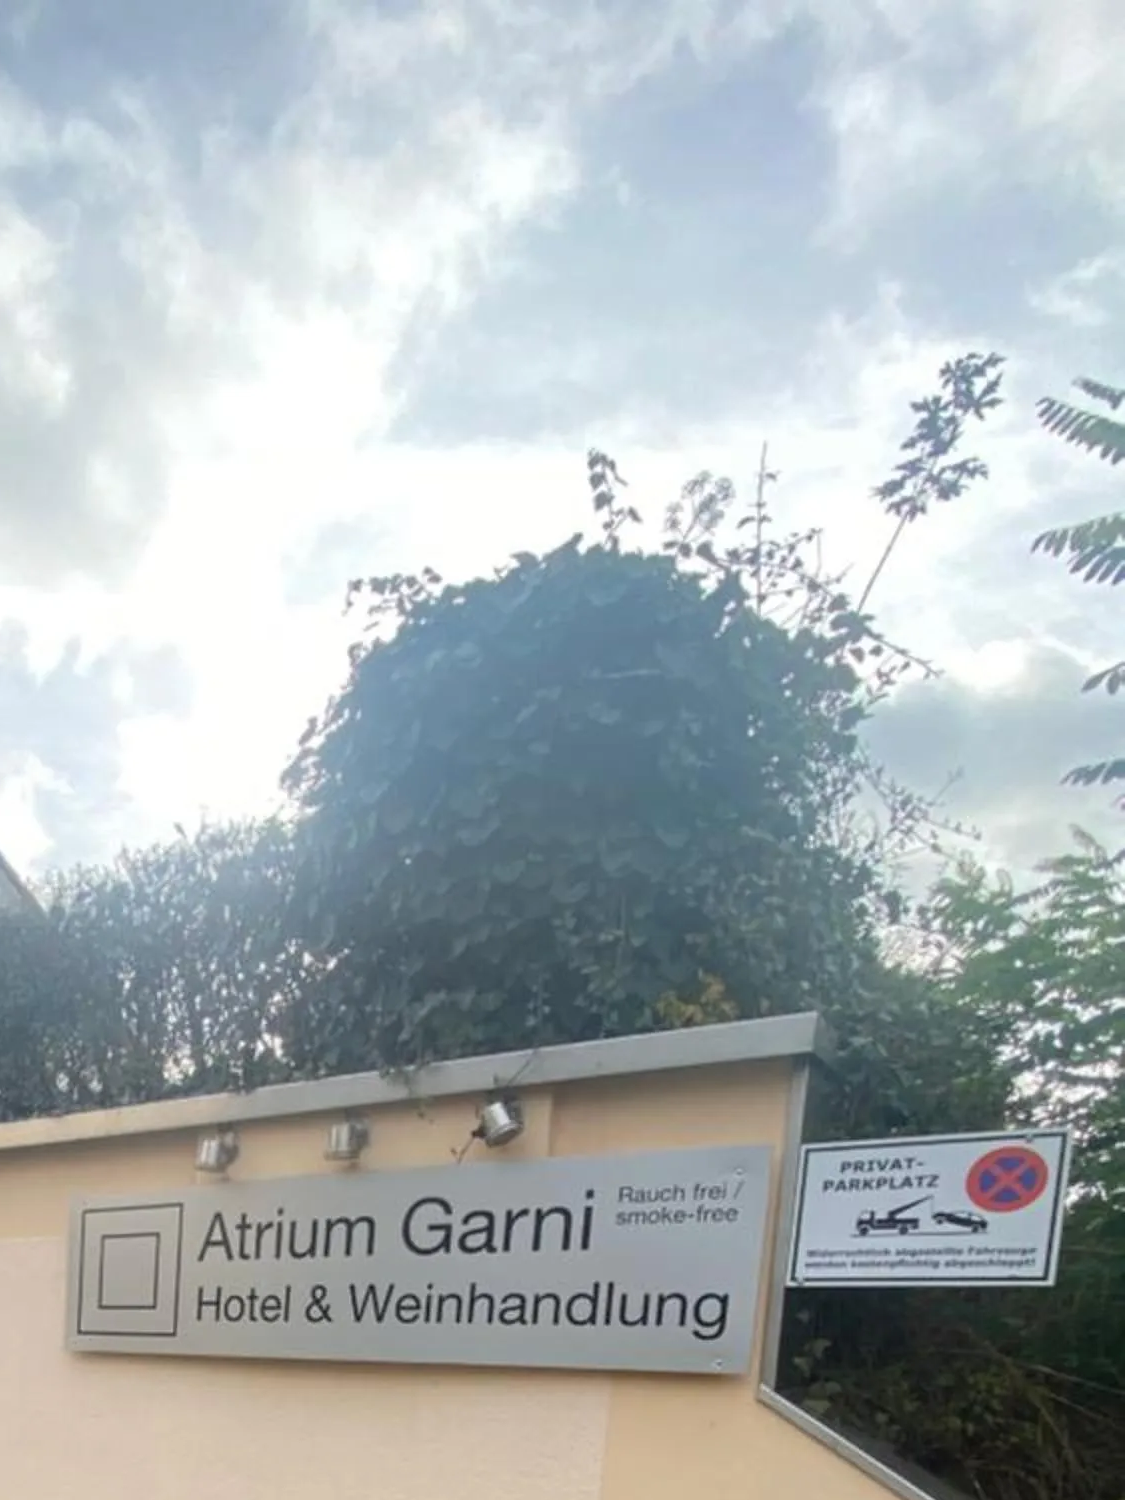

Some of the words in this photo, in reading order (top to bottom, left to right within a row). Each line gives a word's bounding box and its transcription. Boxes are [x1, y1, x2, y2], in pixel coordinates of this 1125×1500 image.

[840, 1156, 925, 1174] PRIVAT-
[618, 1183, 686, 1203] Rauch
[693, 1182, 728, 1201] frei
[822, 1174, 940, 1193] PARKPLATZ
[197, 1207, 375, 1262] Atrium
[402, 1189, 595, 1255] Garni
[615, 1204, 739, 1226] smoke-free
[196, 1284, 291, 1322] Hotel
[305, 1284, 332, 1323] &
[349, 1281, 730, 1341] Weinhandlung
